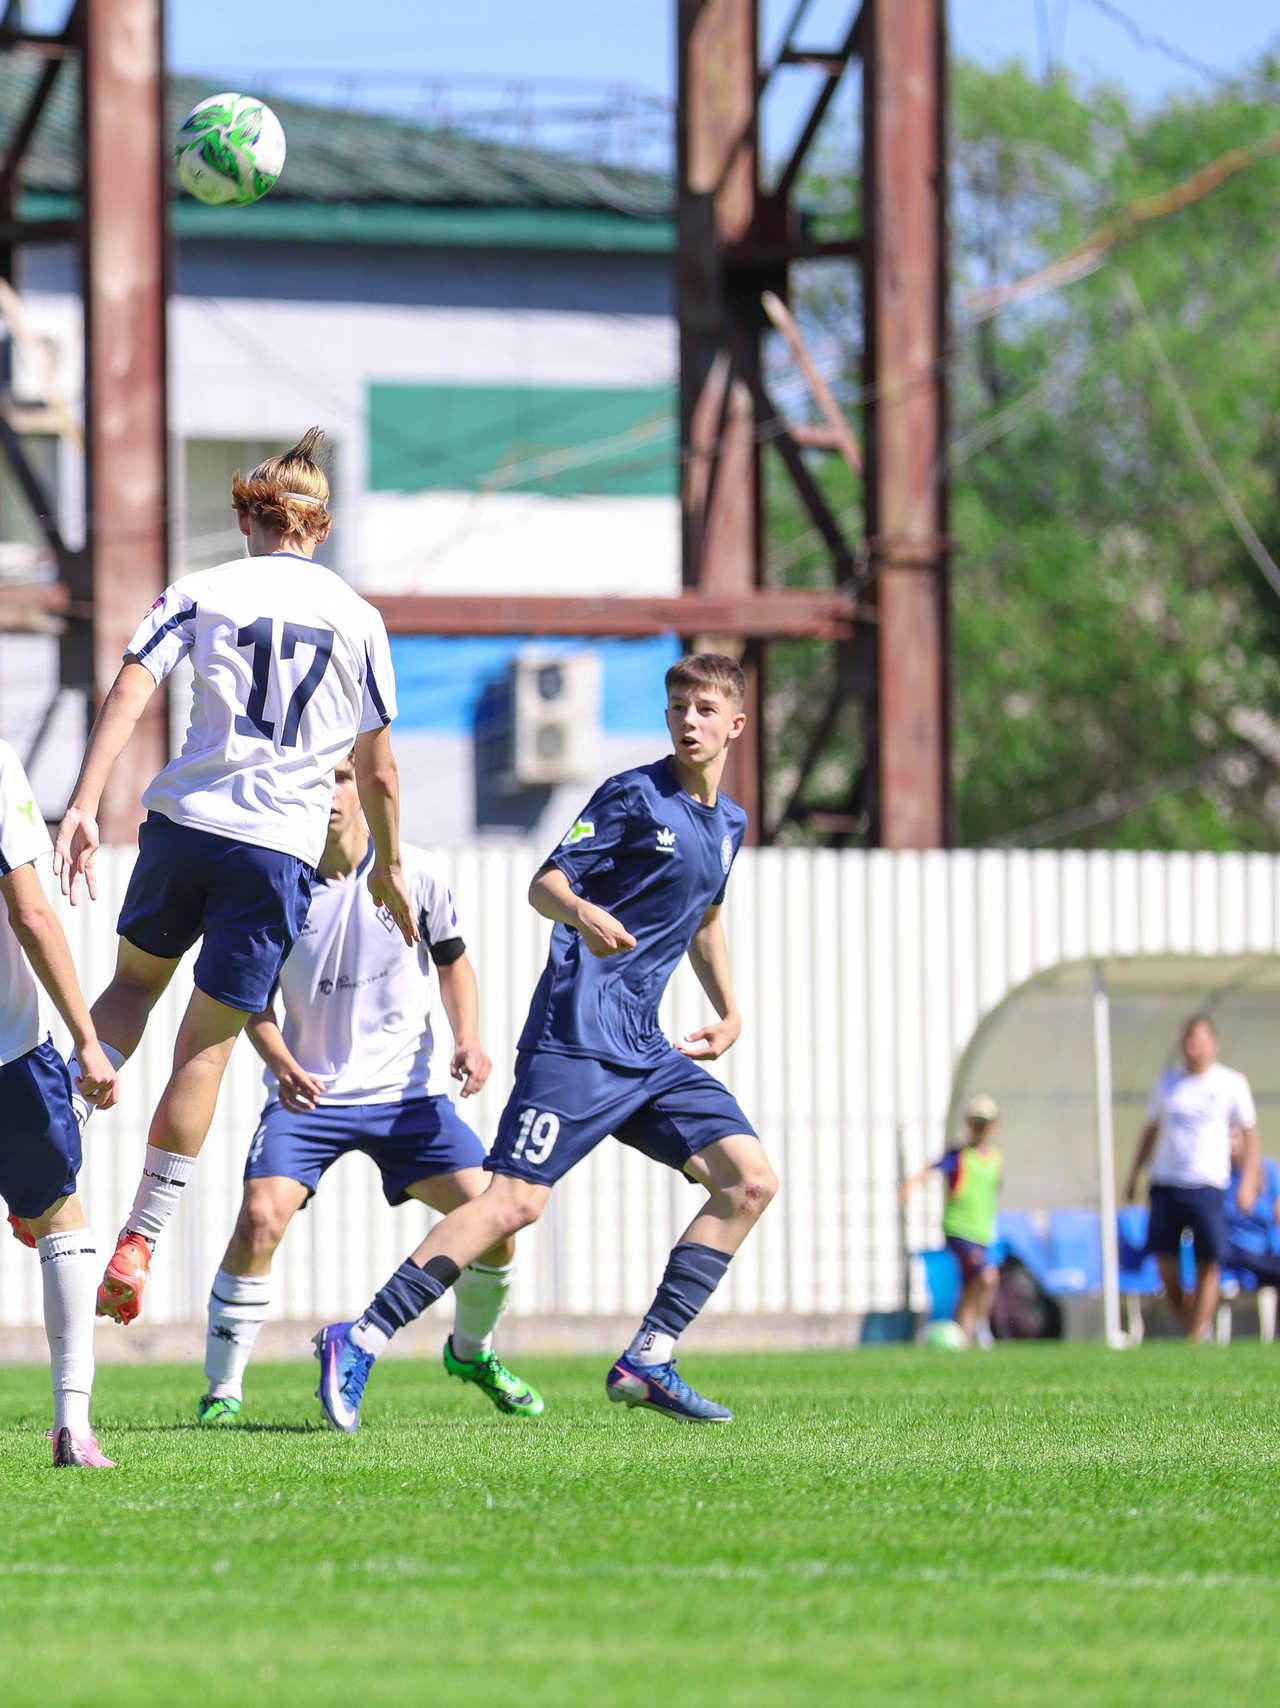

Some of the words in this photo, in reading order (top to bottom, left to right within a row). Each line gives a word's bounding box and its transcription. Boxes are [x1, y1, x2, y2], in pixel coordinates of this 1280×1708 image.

[235, 616, 334, 748] 17
[511, 1108, 560, 1165] 19
[143, 1167, 170, 1185] ELME
[40, 1248, 78, 1264] ELME
